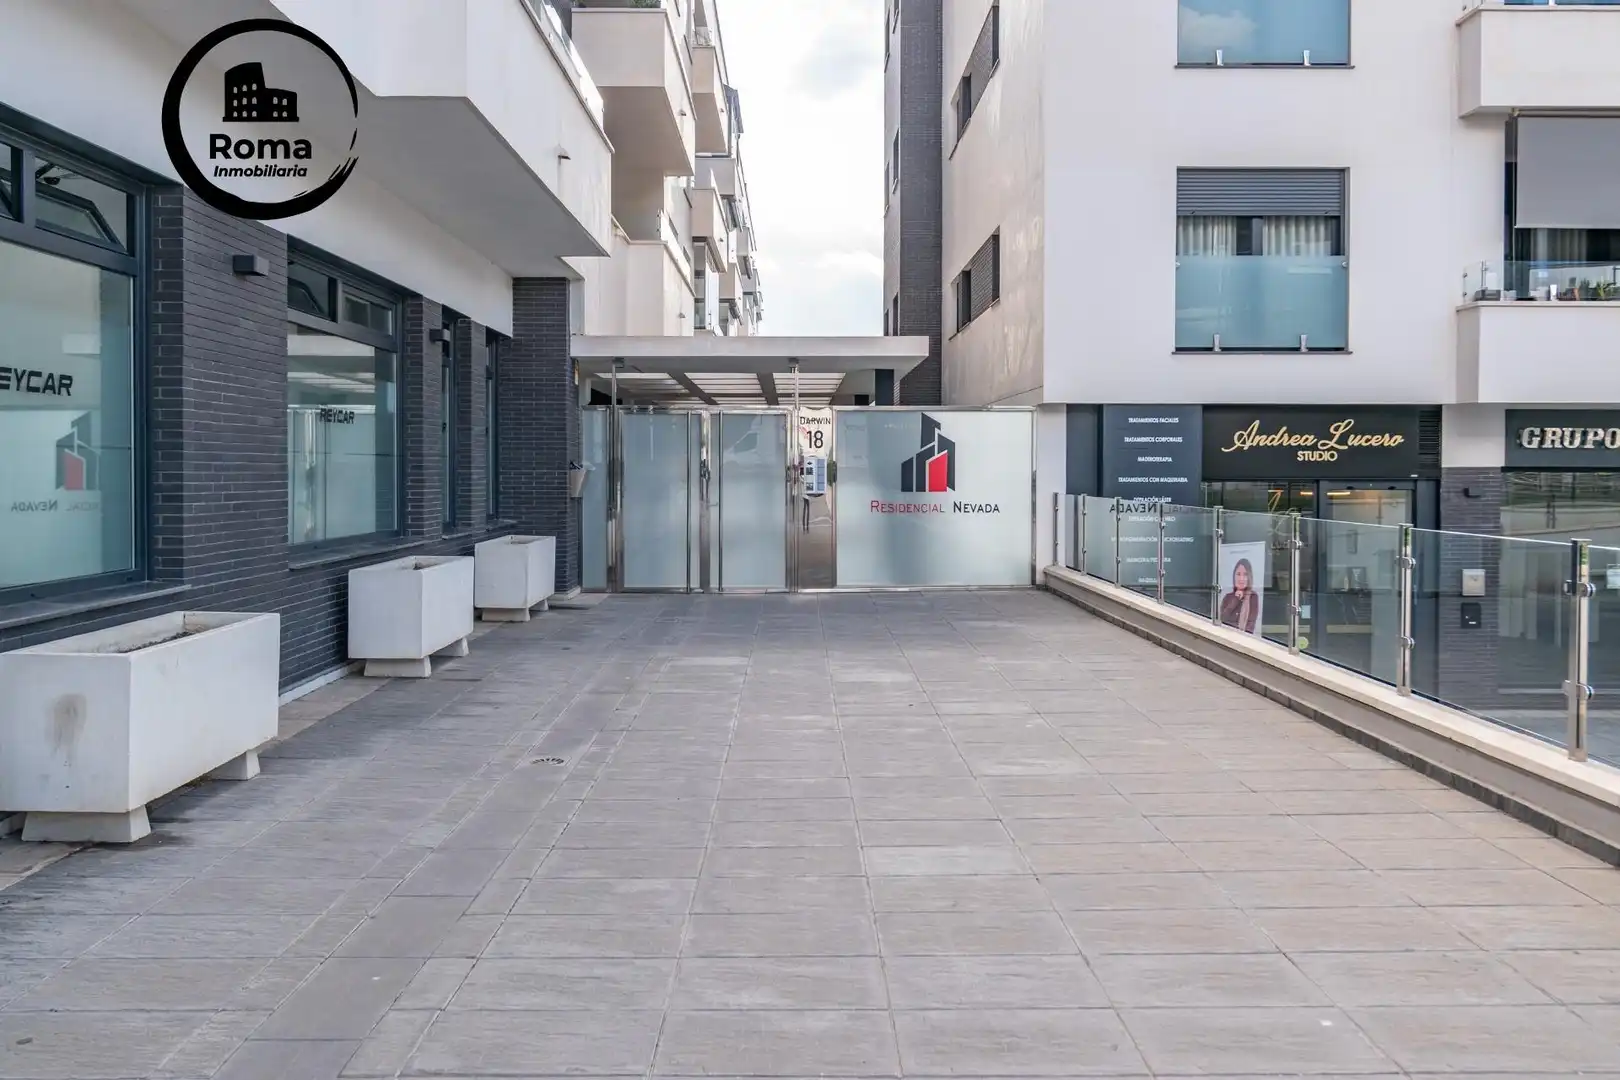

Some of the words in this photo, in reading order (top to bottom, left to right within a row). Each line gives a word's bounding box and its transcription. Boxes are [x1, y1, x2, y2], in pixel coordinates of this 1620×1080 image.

[319, 407, 355, 424] REYCAR
[800, 416, 831, 425] DARWIN
[806, 430, 824, 449] 18
[1221, 419, 1317, 452] Andrea
[1317, 418, 1405, 450] Lucero
[1521, 427, 1620, 449] GRUPO
[1296, 450, 1338, 462] STUDIO
[870, 500, 945, 513] RESIDENCIAL
[953, 500, 1000, 513] NEVADA
